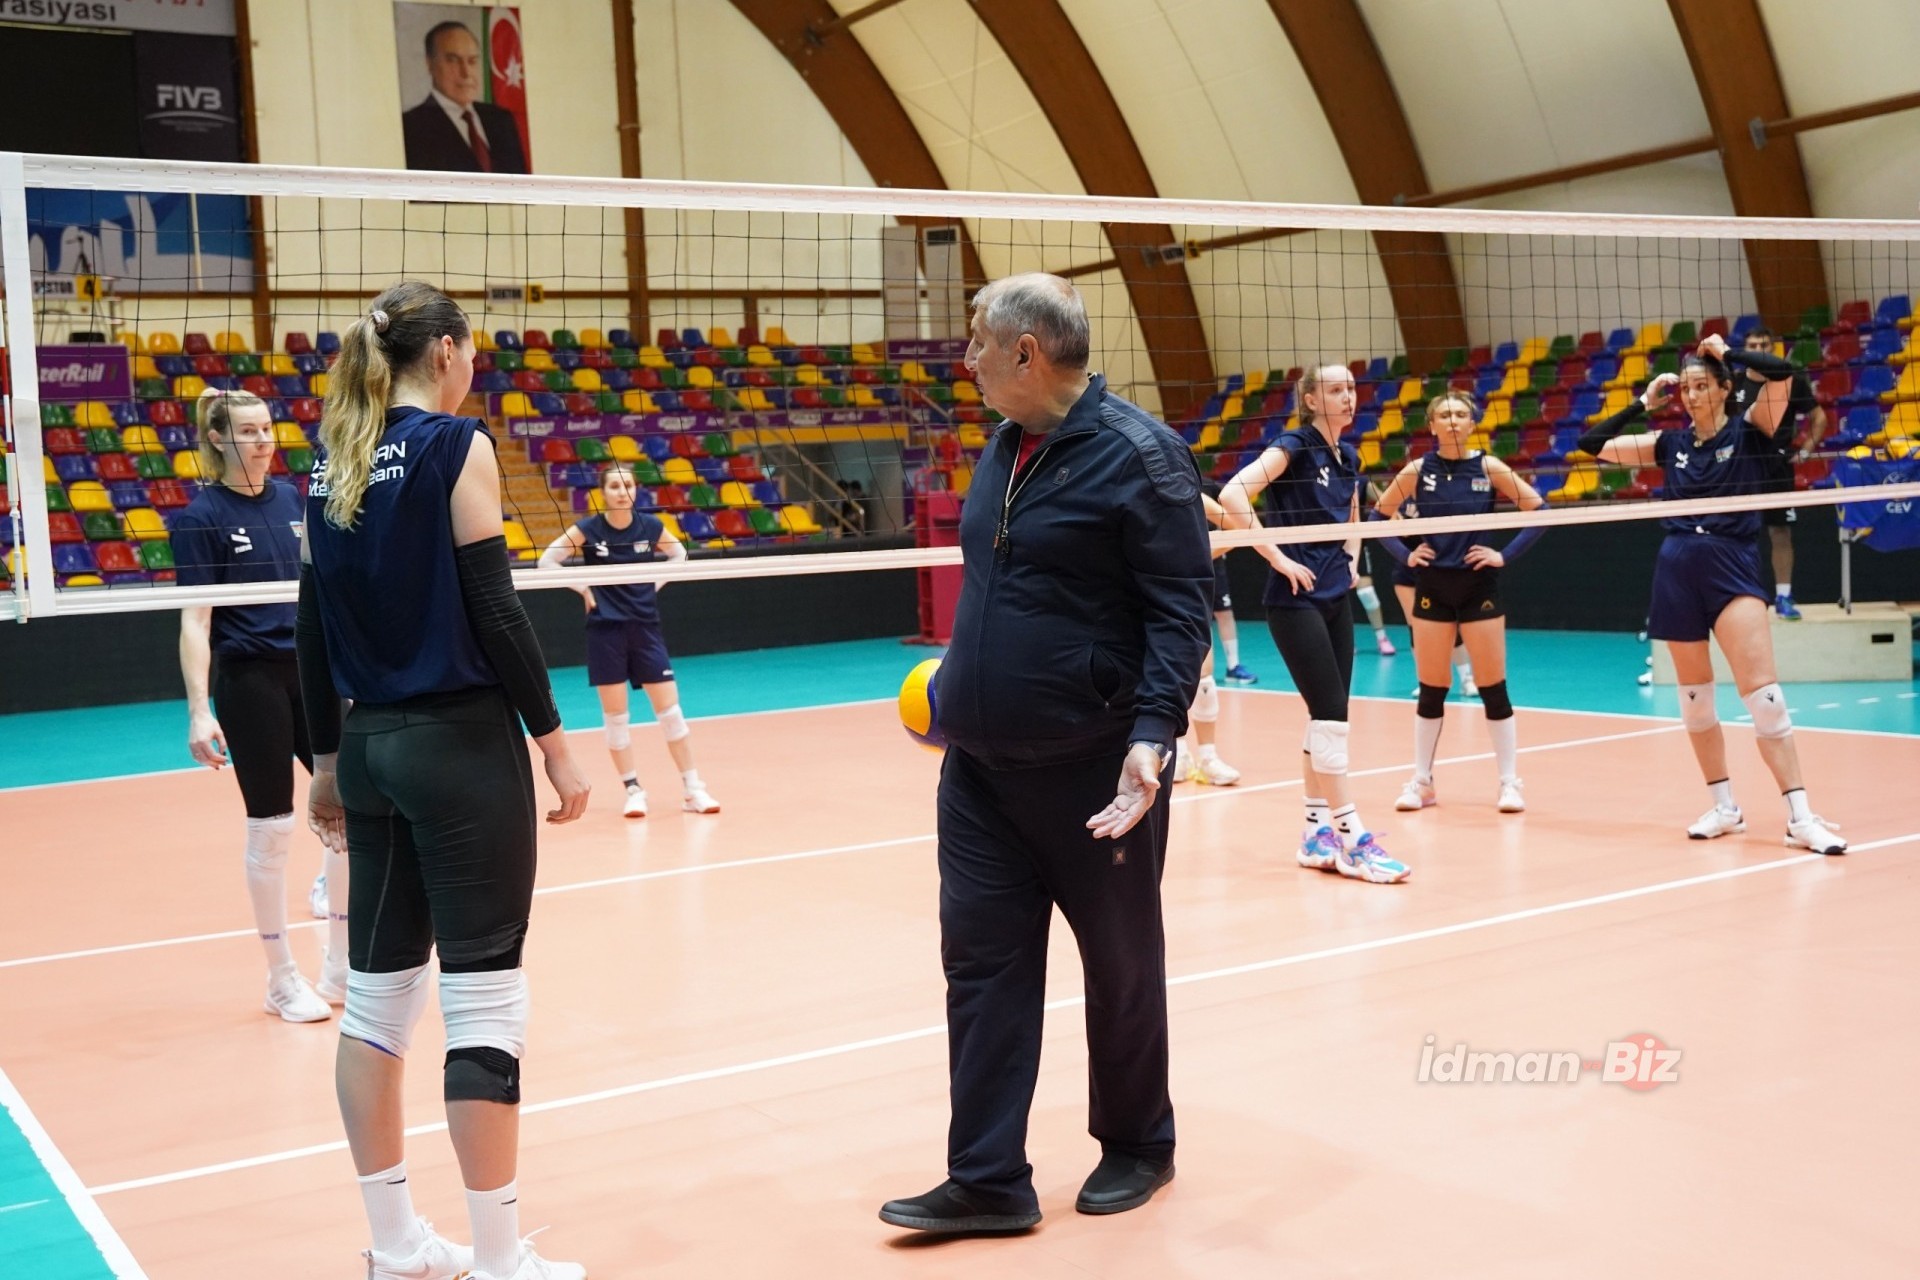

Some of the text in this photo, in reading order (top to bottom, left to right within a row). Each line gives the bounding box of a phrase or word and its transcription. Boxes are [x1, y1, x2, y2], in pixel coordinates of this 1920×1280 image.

[157, 84, 222, 111] FIVB
[40, 363, 104, 382] zerRail
[373, 440, 406, 464] AN
[368, 465, 404, 486] eam
[1885, 501, 1912, 513] CEV
